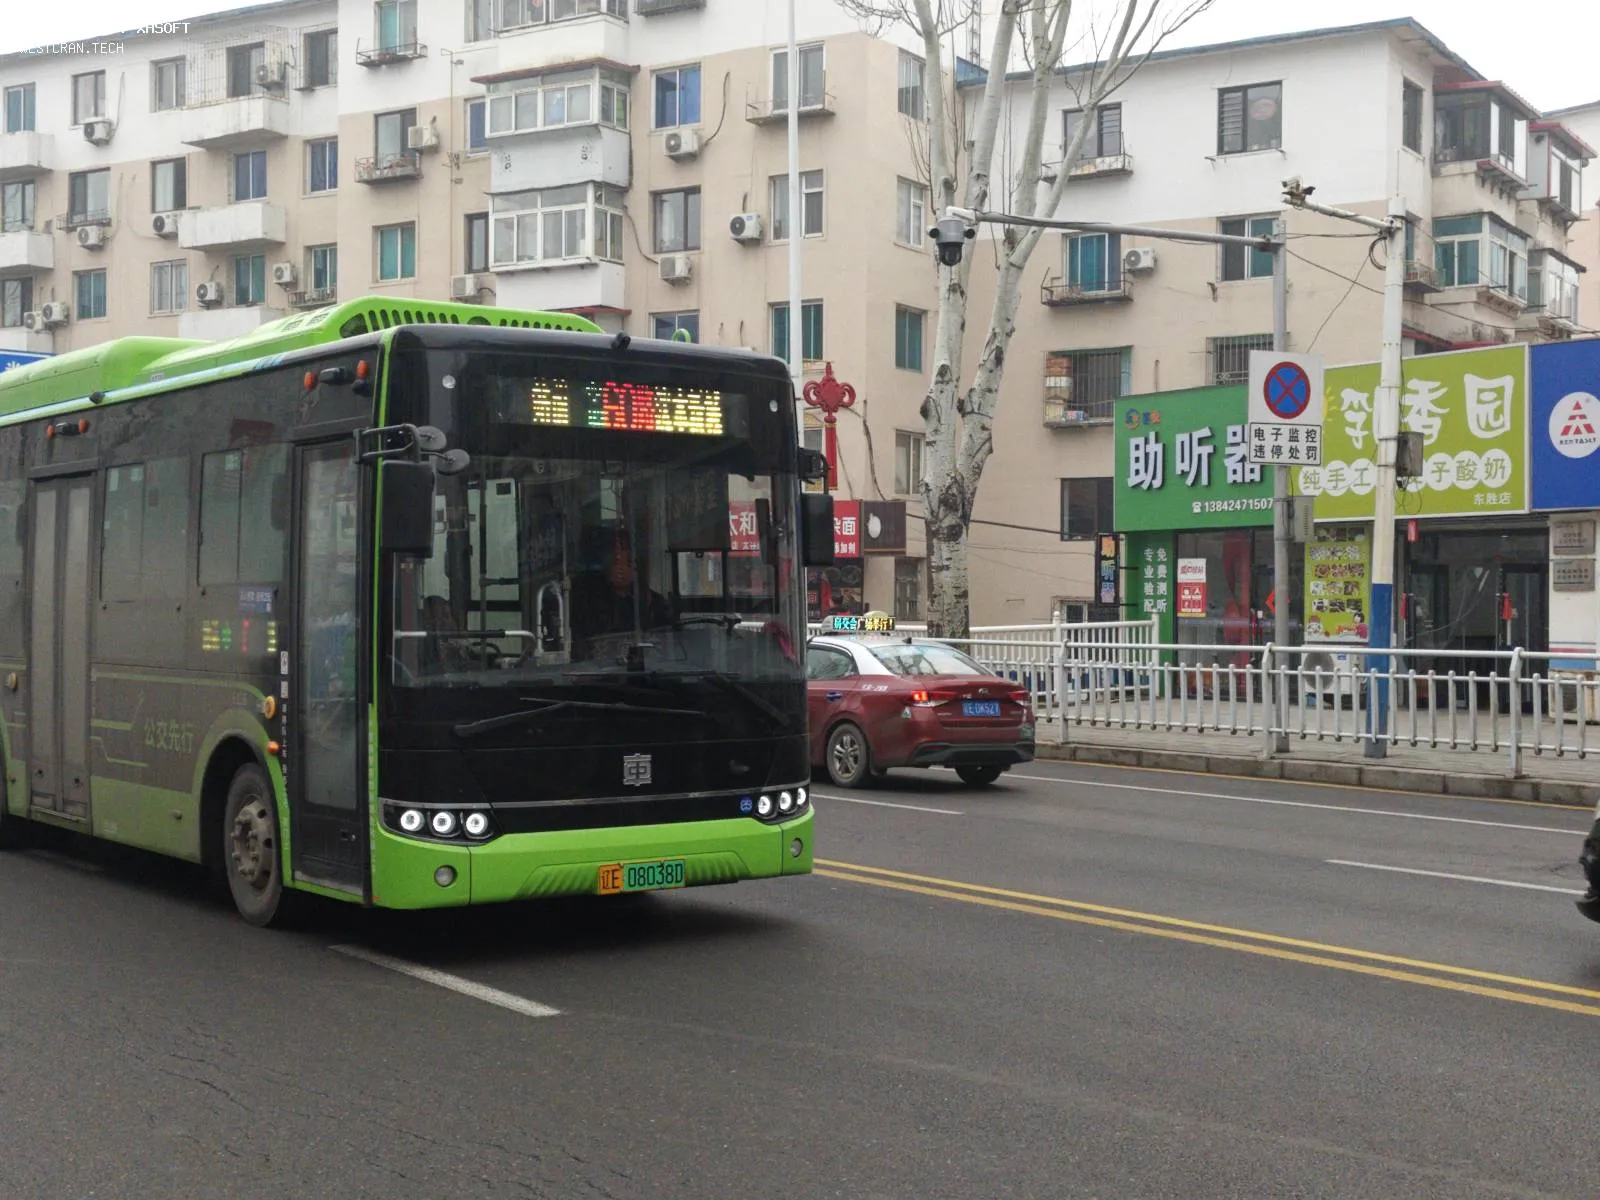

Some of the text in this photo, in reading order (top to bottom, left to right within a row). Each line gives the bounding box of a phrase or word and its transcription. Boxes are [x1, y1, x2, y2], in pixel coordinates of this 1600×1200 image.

[1254, 427, 1318, 443] 电子监控
[1127, 424, 1262, 490] 助听器
[1254, 444, 1318, 461] 违停处罚
[1204, 498, 1274, 513] 13842471507
